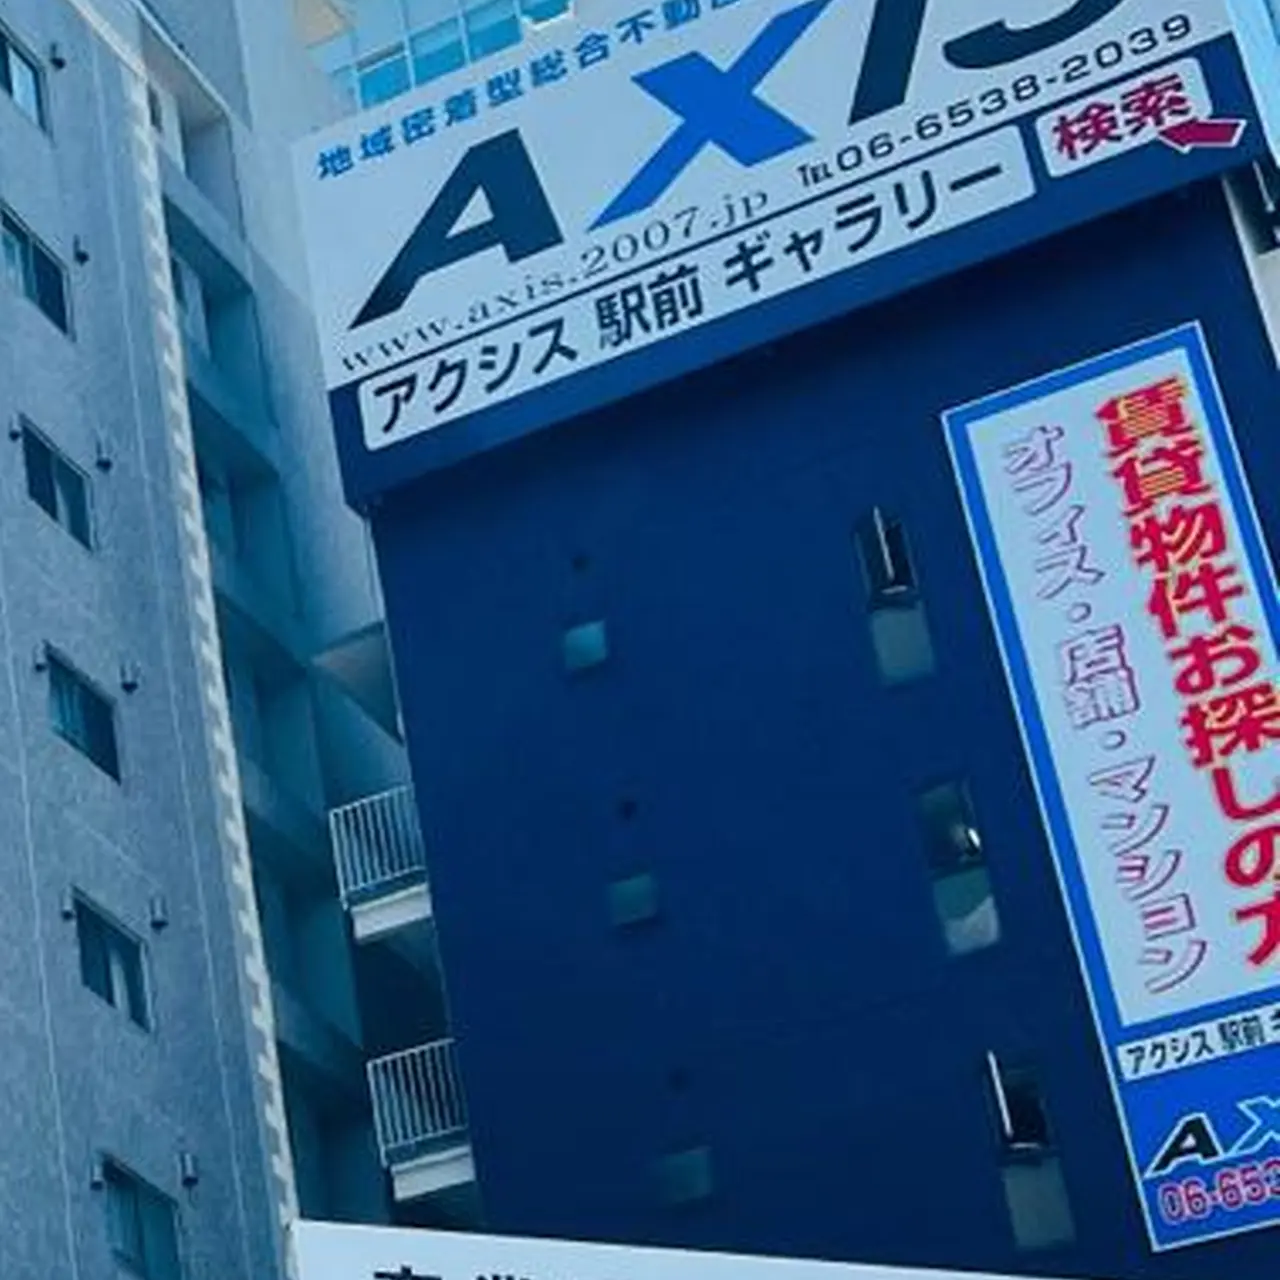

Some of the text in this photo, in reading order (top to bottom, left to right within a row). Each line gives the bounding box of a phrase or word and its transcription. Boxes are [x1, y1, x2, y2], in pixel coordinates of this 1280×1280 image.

[1052, 71, 1193, 162] 検索
[372, 162, 1004, 434] アクシス 駅前 ギャラリー
[1126, 1028, 1215, 1074] アクシス
